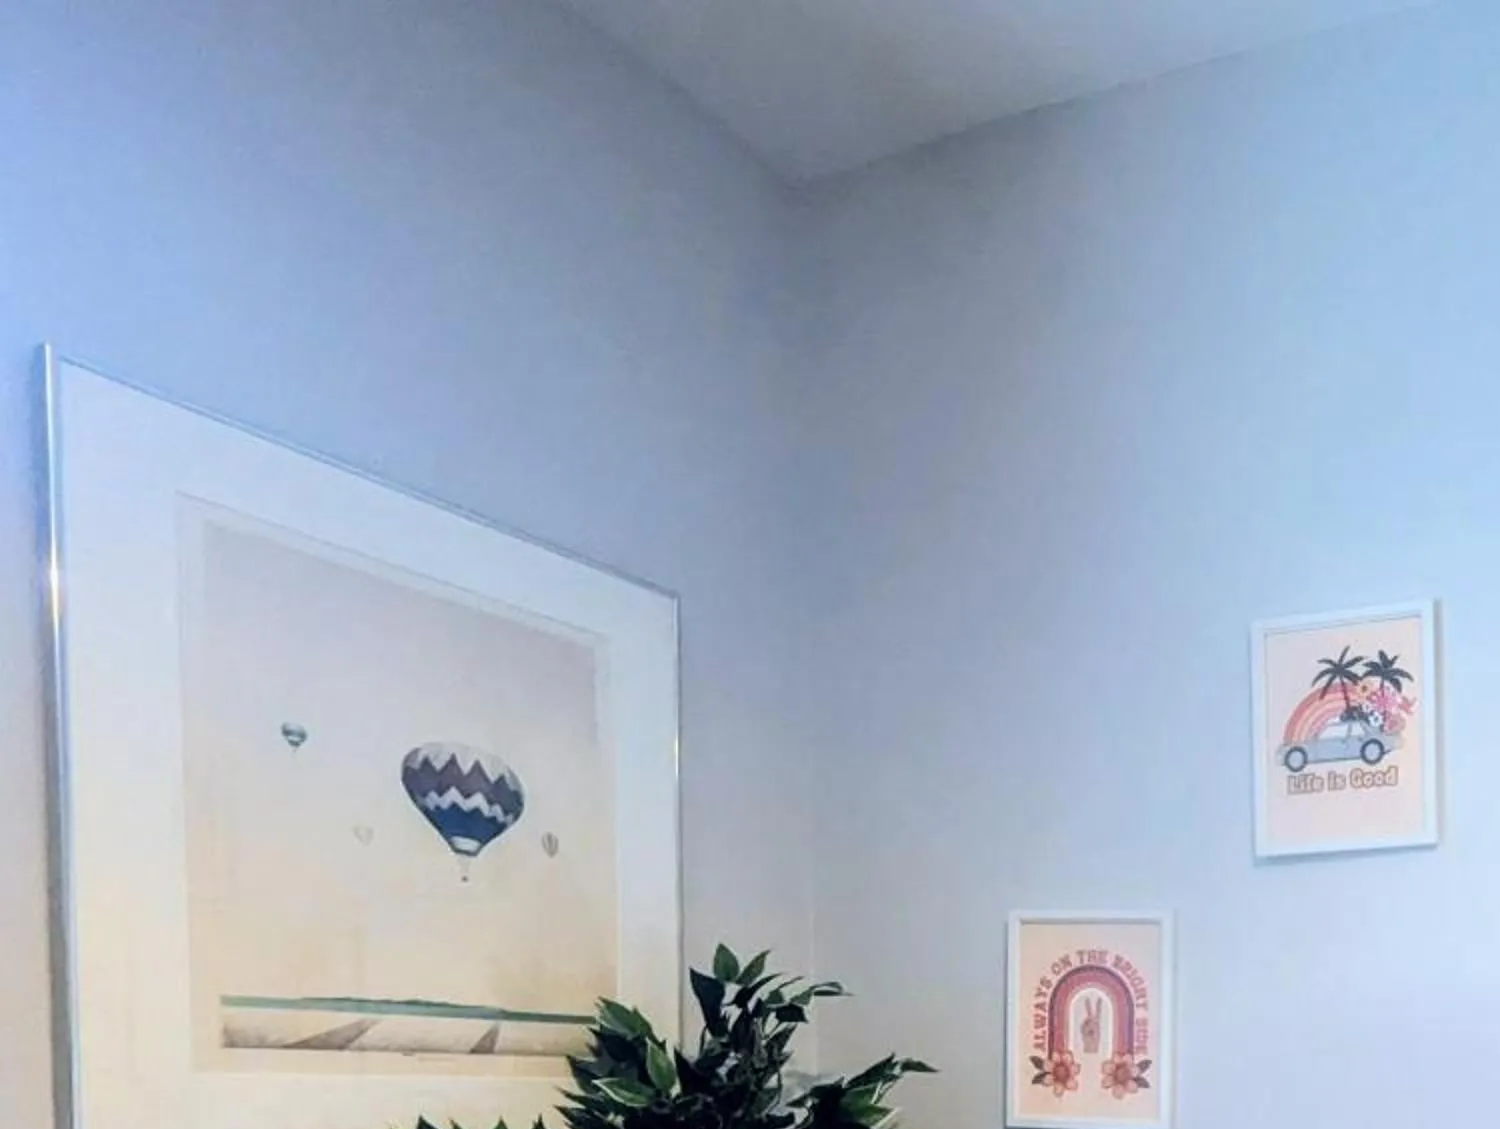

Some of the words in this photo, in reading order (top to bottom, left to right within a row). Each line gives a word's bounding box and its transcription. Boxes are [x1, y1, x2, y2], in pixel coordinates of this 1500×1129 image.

[1287, 772, 1325, 795] Life
[1350, 765, 1399, 789] Good
[1033, 976, 1053, 1051] ALWAYS
[1050, 953, 1073, 975] ON
[1076, 949, 1109, 965] THE
[1113, 954, 1149, 1011] BRIGHT
[1135, 1018, 1149, 1055] SIDE
